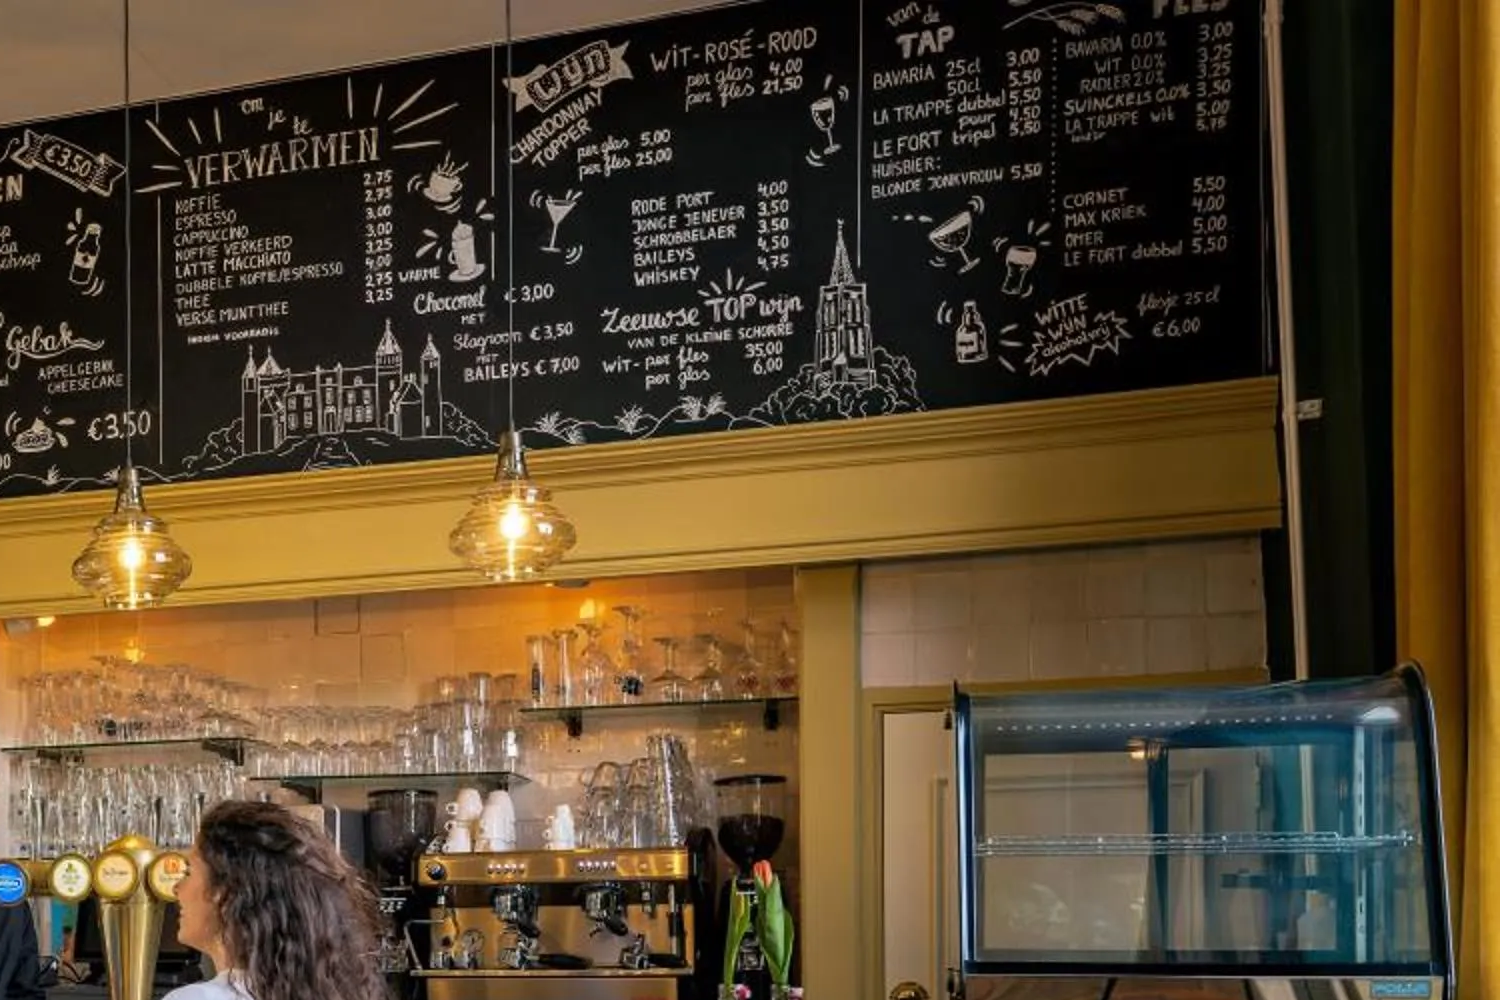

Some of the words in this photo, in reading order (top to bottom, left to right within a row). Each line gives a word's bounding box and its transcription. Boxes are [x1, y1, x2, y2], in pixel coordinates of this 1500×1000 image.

[895, 25, 956, 60] TAP
[873, 63, 936, 91] BAVARIA
[1094, 57, 1123, 75] WIT
[1080, 73, 1131, 95] RADLER
[873, 108, 889, 126] LA
[893, 99, 953, 123] TRAPPE
[957, 88, 1006, 113] dubbel
[1063, 90, 1152, 117] SWINCKELS
[267, 106, 287, 132] je
[509, 87, 603, 164] CHARDONNAY
[1065, 117, 1082, 135] LA
[1085, 110, 1140, 131] TRAPPE
[531, 117, 593, 169] TOPPER
[873, 139, 893, 159] LE
[897, 129, 943, 155] FORT
[952, 122, 996, 148] tripel
[184, 126, 381, 190] VERWARMEN
[871, 178, 922, 200] BLONDE
[1063, 187, 1129, 210] CORNET
[631, 196, 668, 217] RODE
[676, 190, 715, 209] PORT
[175, 209, 237, 231] ESPRESSO
[684, 205, 746, 228] JENEVER
[1065, 211, 1098, 229] MAX
[1101, 204, 1147, 223] KRIEK
[223, 235, 293, 257] VERKEERD
[633, 223, 738, 250] SCHROBBELAER
[1065, 231, 1104, 250] OMER
[175, 260, 217, 279] LATTE
[223, 251, 291, 272] MACCHIATO
[633, 247, 696, 267] BAILEYS
[1064, 250, 1083, 268] LE
[1088, 245, 1128, 265] FORT
[1131, 239, 1184, 261] dubbel
[175, 275, 234, 295] DUBBELE
[633, 265, 701, 287] WHISKEY
[174, 293, 211, 311] THEE
[600, 307, 701, 333] Zeeuwse
[703, 292, 757, 323] TOP
[759, 294, 804, 323] wijn
[1035, 291, 1089, 326] WITTE
[627, 337, 655, 350] VAN
[659, 333, 679, 346] DE
[738, 322, 794, 340] SCHORRE
[676, 345, 710, 370] fles
[47, 373, 125, 395] CHEESECAKE
[464, 361, 530, 383] BAILEYS
[677, 366, 711, 390] glas
